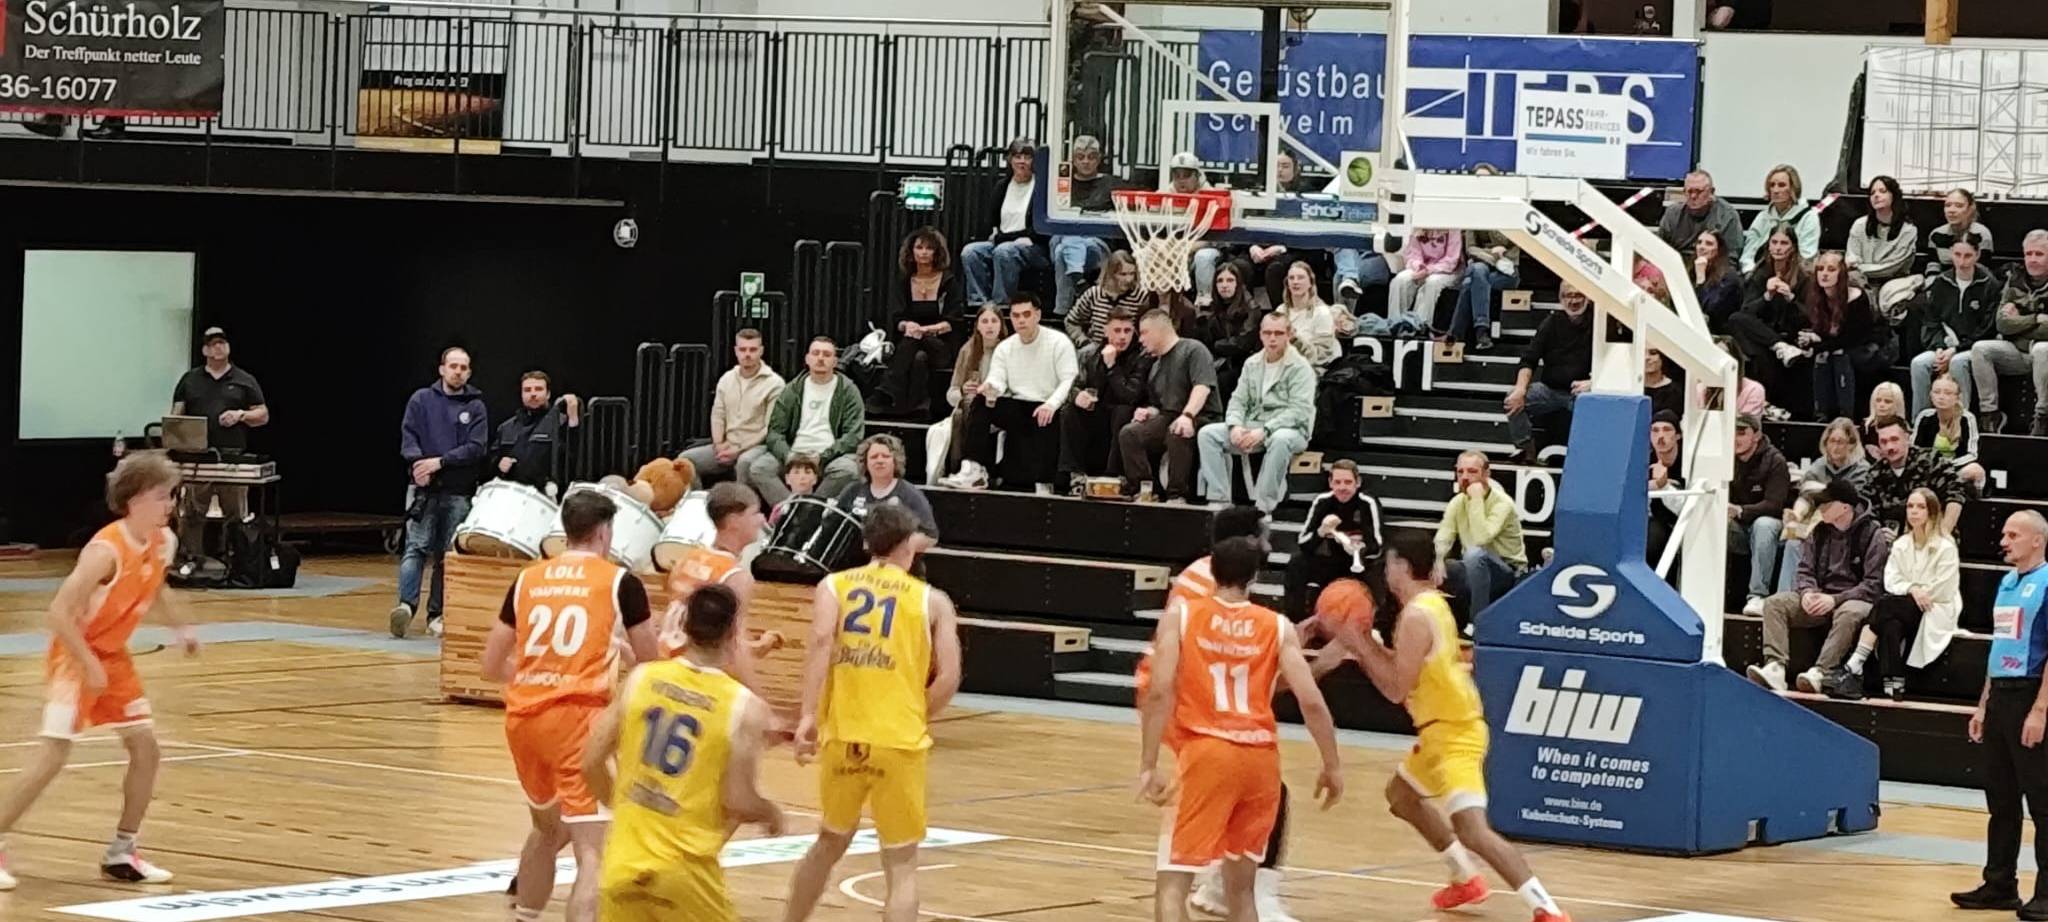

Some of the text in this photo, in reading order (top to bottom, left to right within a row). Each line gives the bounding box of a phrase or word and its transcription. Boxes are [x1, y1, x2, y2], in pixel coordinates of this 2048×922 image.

[25, 1, 201, 40] Schürholz
[25, 45, 201, 65] Der Treffpunkt netter Leute
[1526, 106, 1584, 129] TEPASS
[544, 565, 586, 580] LOLL
[843, 587, 897, 638] 21
[1210, 614, 1254, 638] PAGE
[524, 604, 588, 657] 20
[1588, 627, 1645, 645] Sports
[1208, 662, 1250, 714] 11
[1504, 665, 1643, 744] biw
[641, 706, 703, 778] 16
[1538, 746, 1650, 774] When it comes
[1531, 765, 1644, 790] to competence
